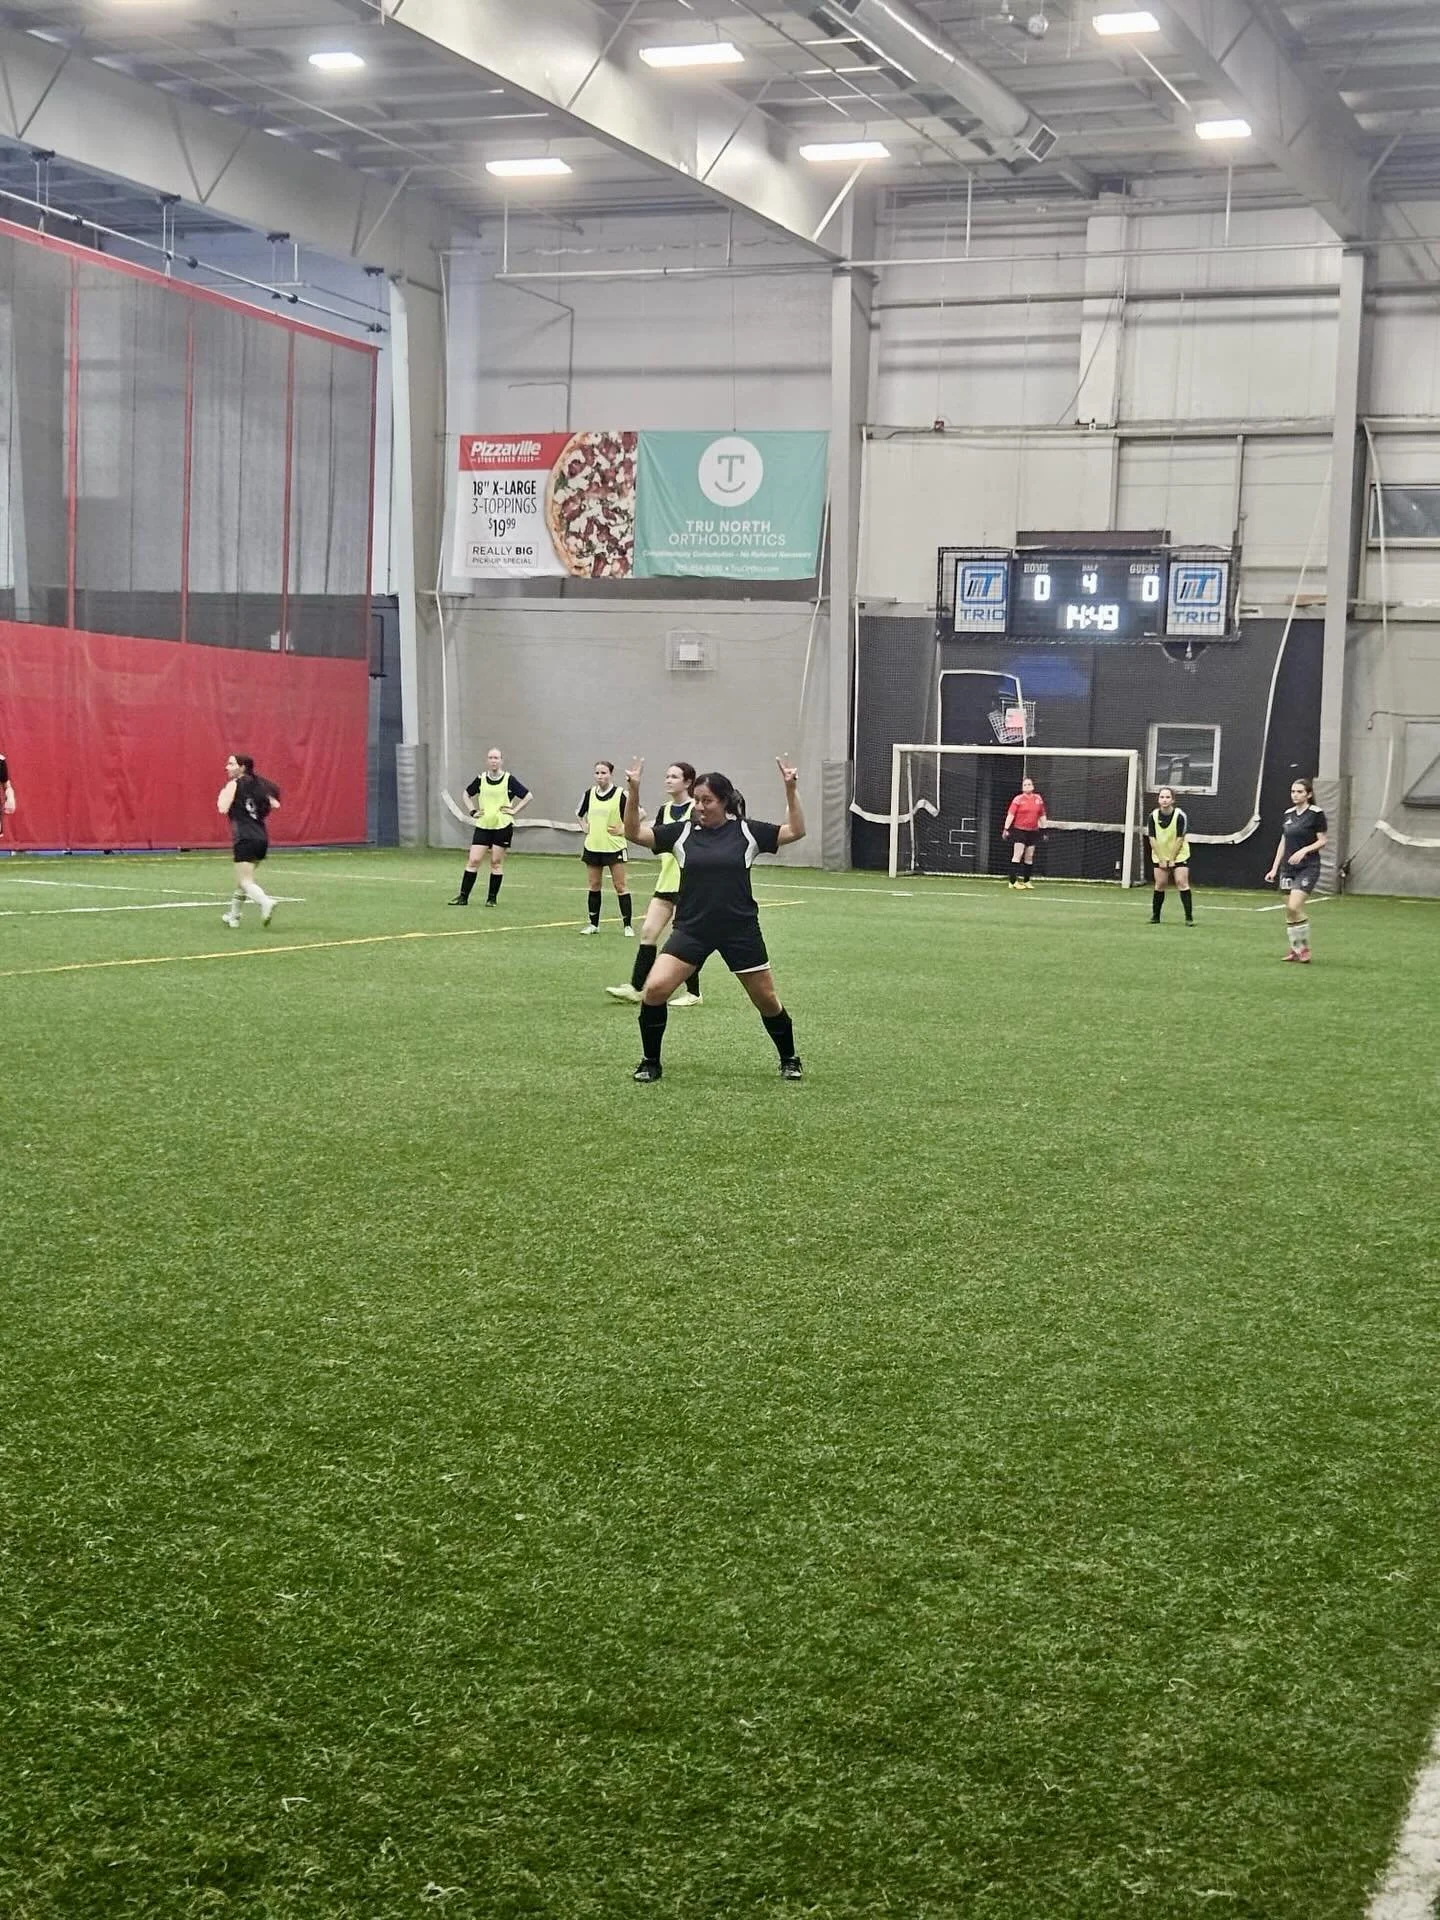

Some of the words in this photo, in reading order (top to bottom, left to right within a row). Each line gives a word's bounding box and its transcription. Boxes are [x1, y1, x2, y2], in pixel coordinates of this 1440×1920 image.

[470, 440, 542, 457] Pizzaville
[473, 480, 490, 496] 18"
[492, 480, 537, 496] X-LARGE
[471, 497, 538, 514] 3-TOPPINGS
[686, 520, 714, 533] TRU
[719, 520, 772, 533] NORTH
[668, 533, 786, 546] ORTHODONTICS
[472, 546, 513, 556] REALLY
[515, 546, 534, 556] BIG
[1023, 563, 1050, 573] HOME
[1129, 563, 1160, 574] GUEST
[1034, 574, 1051, 601] 0
[1082, 572, 1098, 595] 4
[1142, 575, 1160, 602] 0
[960, 609, 1006, 620] TRIO
[1172, 611, 1221, 623] TRIO
